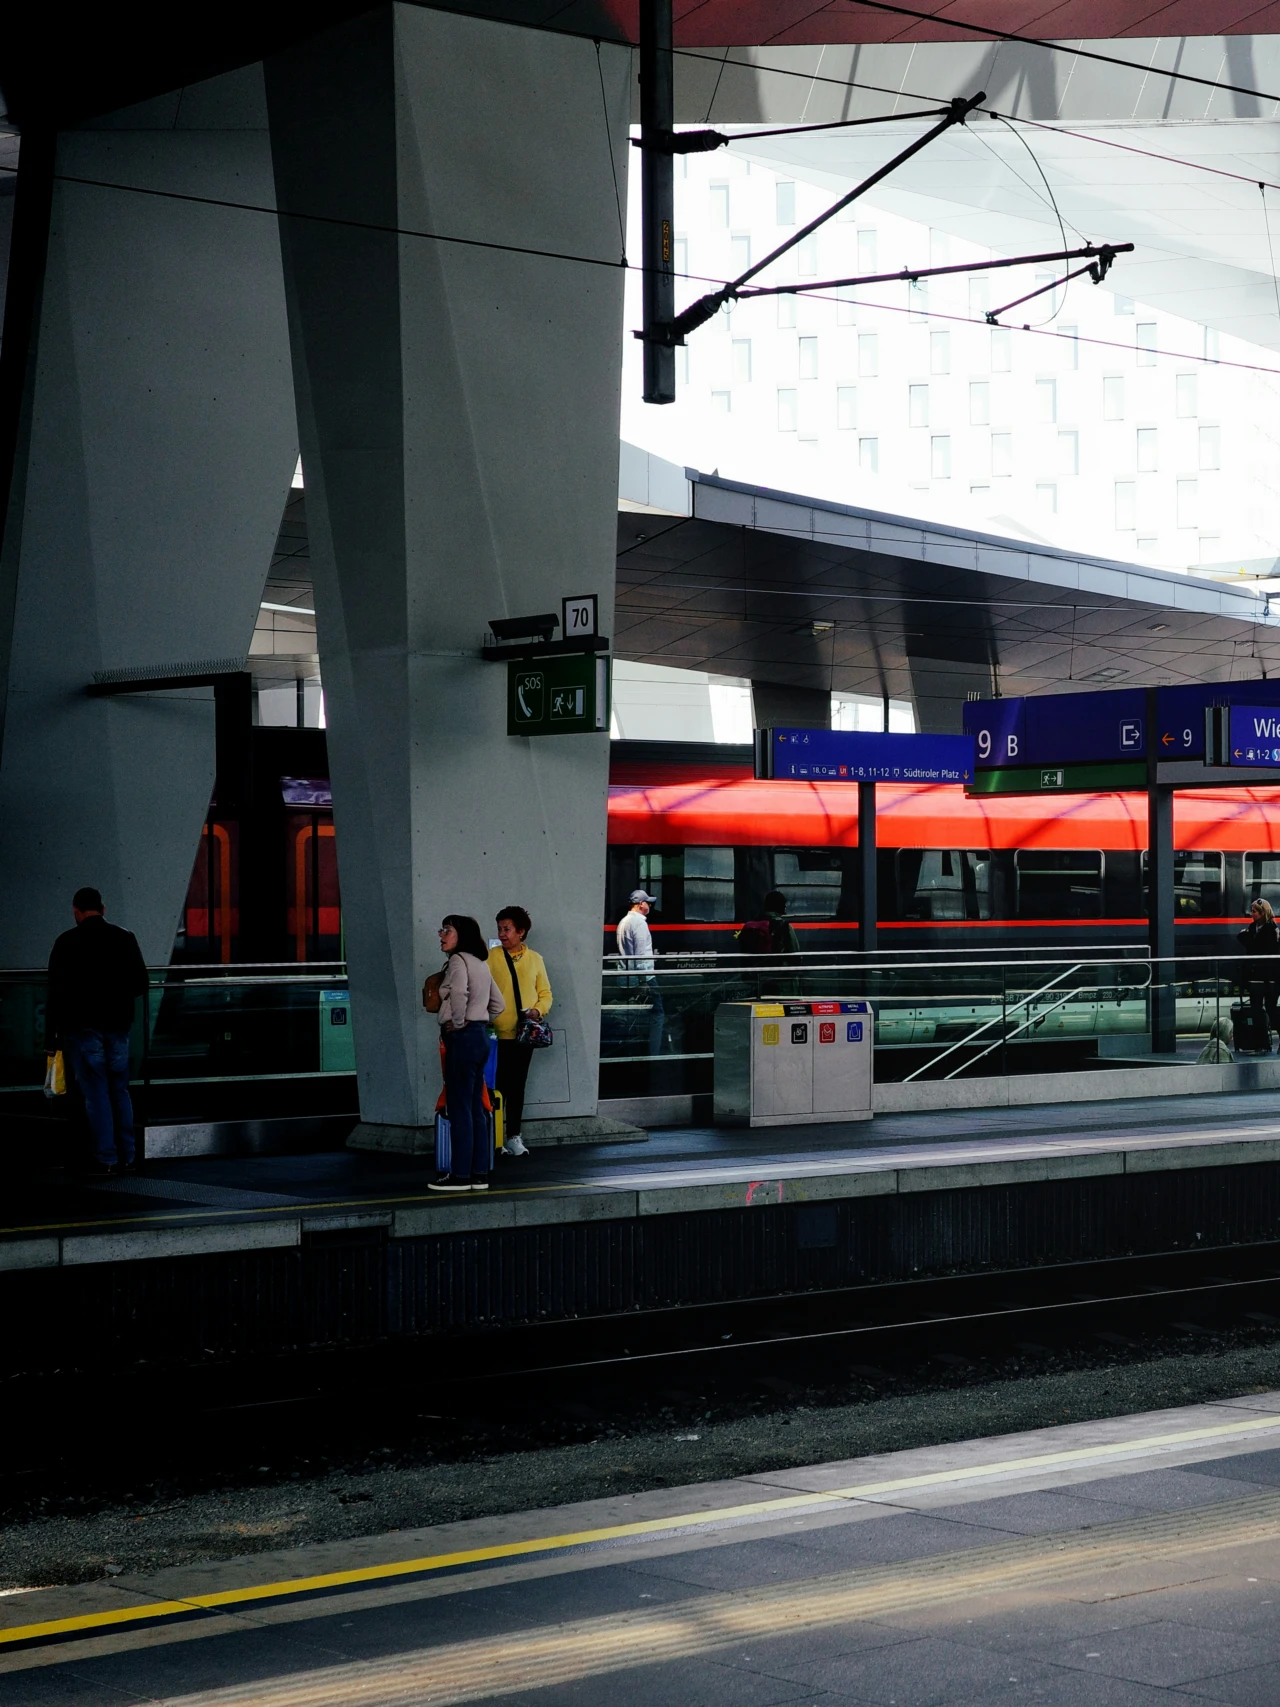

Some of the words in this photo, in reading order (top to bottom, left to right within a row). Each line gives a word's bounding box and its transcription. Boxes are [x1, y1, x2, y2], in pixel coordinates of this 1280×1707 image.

[571, 607, 589, 628] 70
[524, 676, 541, 690] SOS
[977, 729, 992, 759] 9
[1007, 734, 1019, 757] B
[1182, 728, 1192, 747] 9
[1256, 750, 1270, 760] 1-2
[850, 767, 866, 777] 1-8,
[868, 768, 890, 777] 11-12
[903, 768, 940, 778] Südtiroler
[941, 770, 960, 779] Platz
[676, 961, 717, 969] ruhezone
